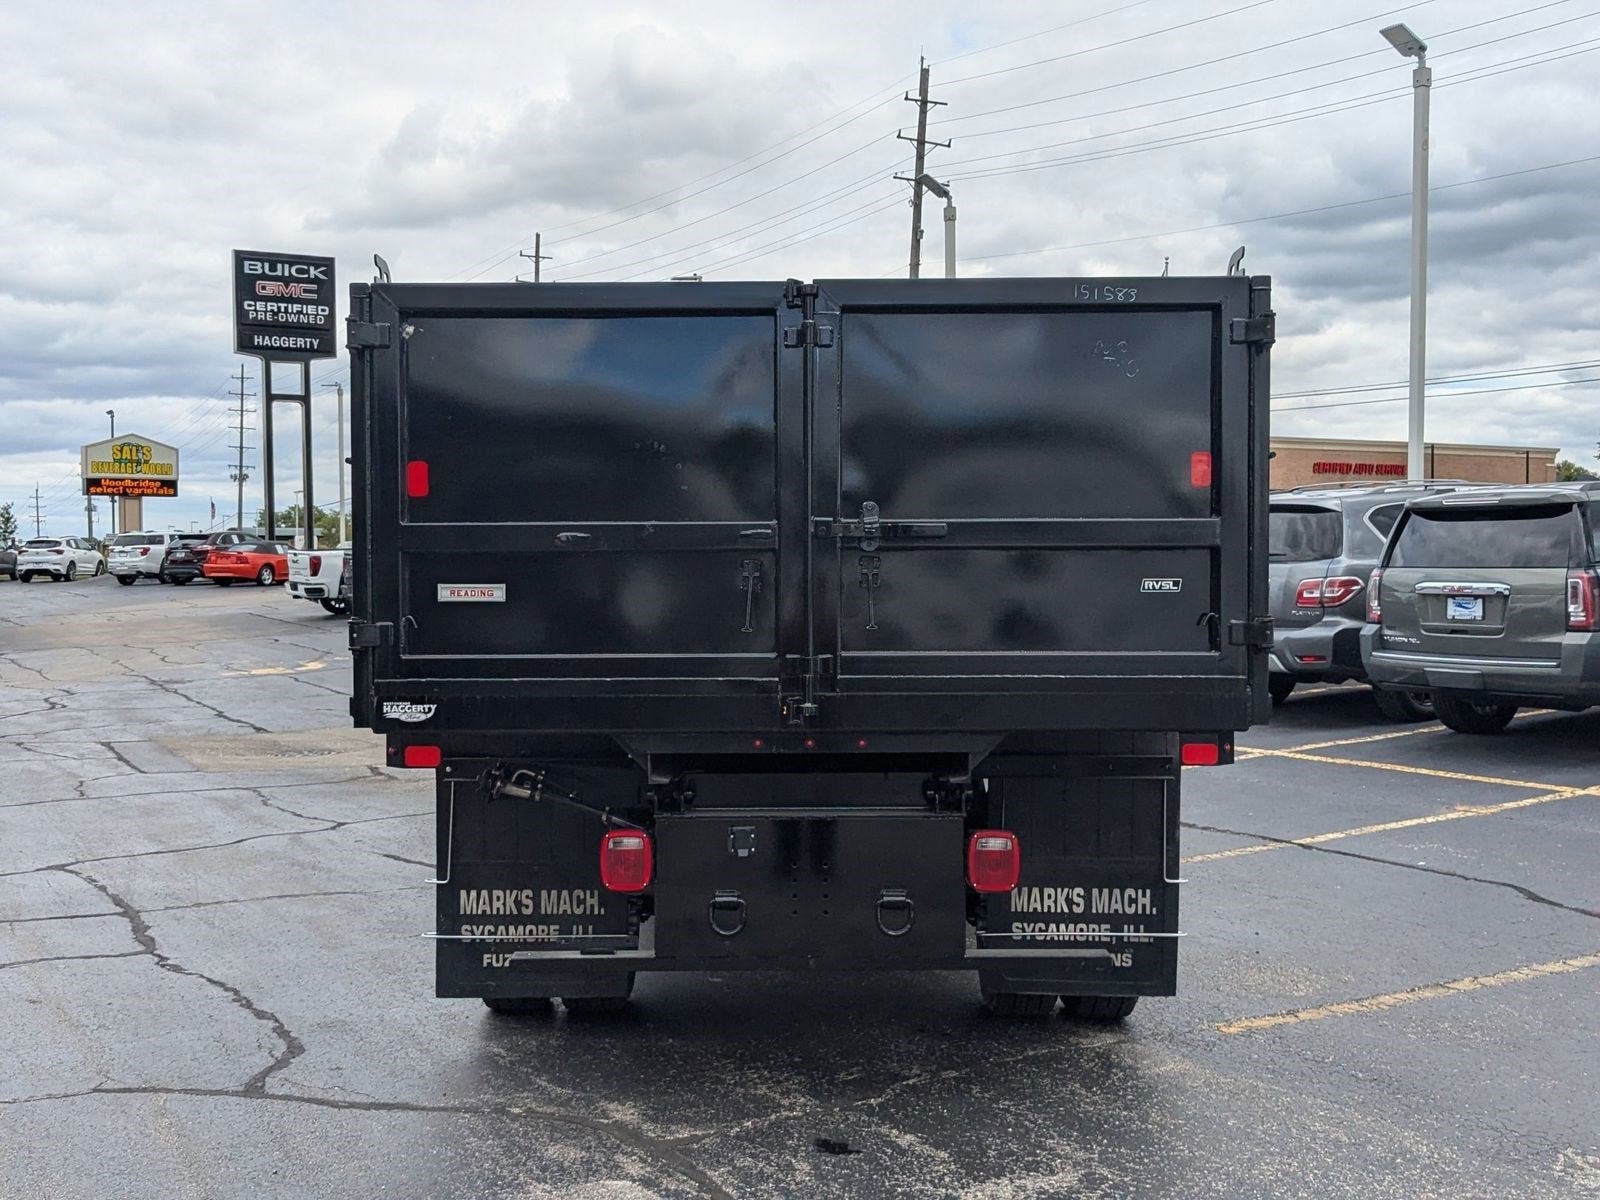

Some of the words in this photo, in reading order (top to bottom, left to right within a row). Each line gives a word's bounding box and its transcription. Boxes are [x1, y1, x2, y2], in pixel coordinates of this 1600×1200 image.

[243, 260, 329, 280] BUICK
[255, 280, 318, 299] GMC
[1073, 284, 1138, 302] 151583
[243, 300, 330, 315] CERTIFIED
[249, 311, 325, 324] PRE-OWNED
[254, 335, 320, 350] HAGGERTY
[89, 486, 123, 494] select
[126, 486, 175, 495] varietals
[101, 478, 162, 488] Woodbridge
[1144, 580, 1178, 590] RVSL
[449, 589, 495, 597] READING
[383, 704, 437, 713] HAGGERTY
[459, 888, 534, 915] MARK'S
[540, 888, 605, 916] MACH.
[1010, 886, 1085, 914] MARK'S
[1091, 888, 1157, 915] MACH.
[1011, 922, 1116, 945] SYCAMORE,
[1123, 924, 1154, 943] ILL.
